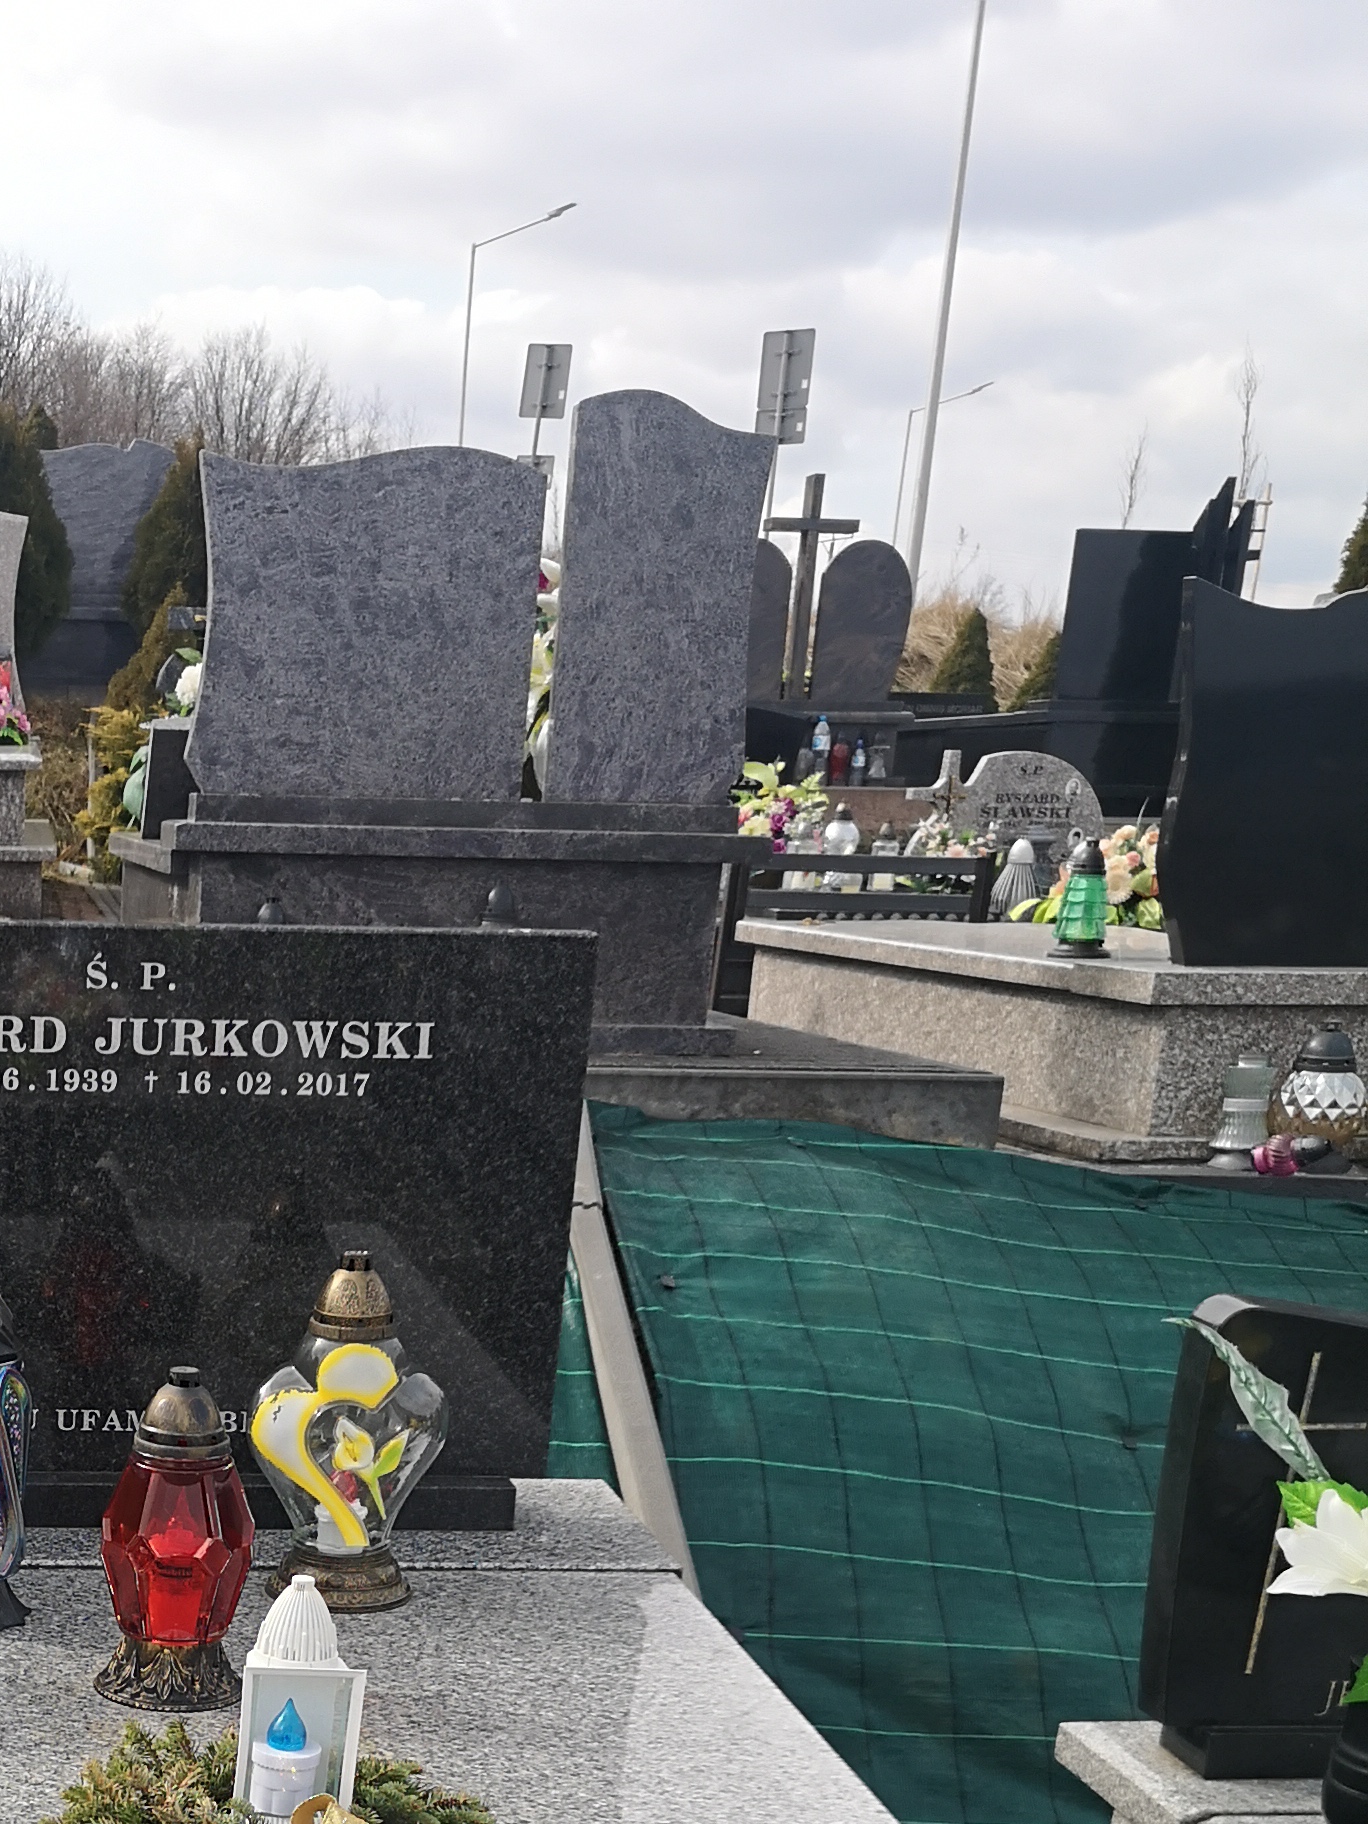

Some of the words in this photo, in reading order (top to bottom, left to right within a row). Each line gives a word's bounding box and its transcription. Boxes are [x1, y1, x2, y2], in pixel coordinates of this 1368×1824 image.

[995, 792, 1062, 804] RYSZARD
[86, 951, 119, 990] Ś.
[139, 961, 177, 992] P.
[94, 1016, 436, 1060] JURKOWSKI
